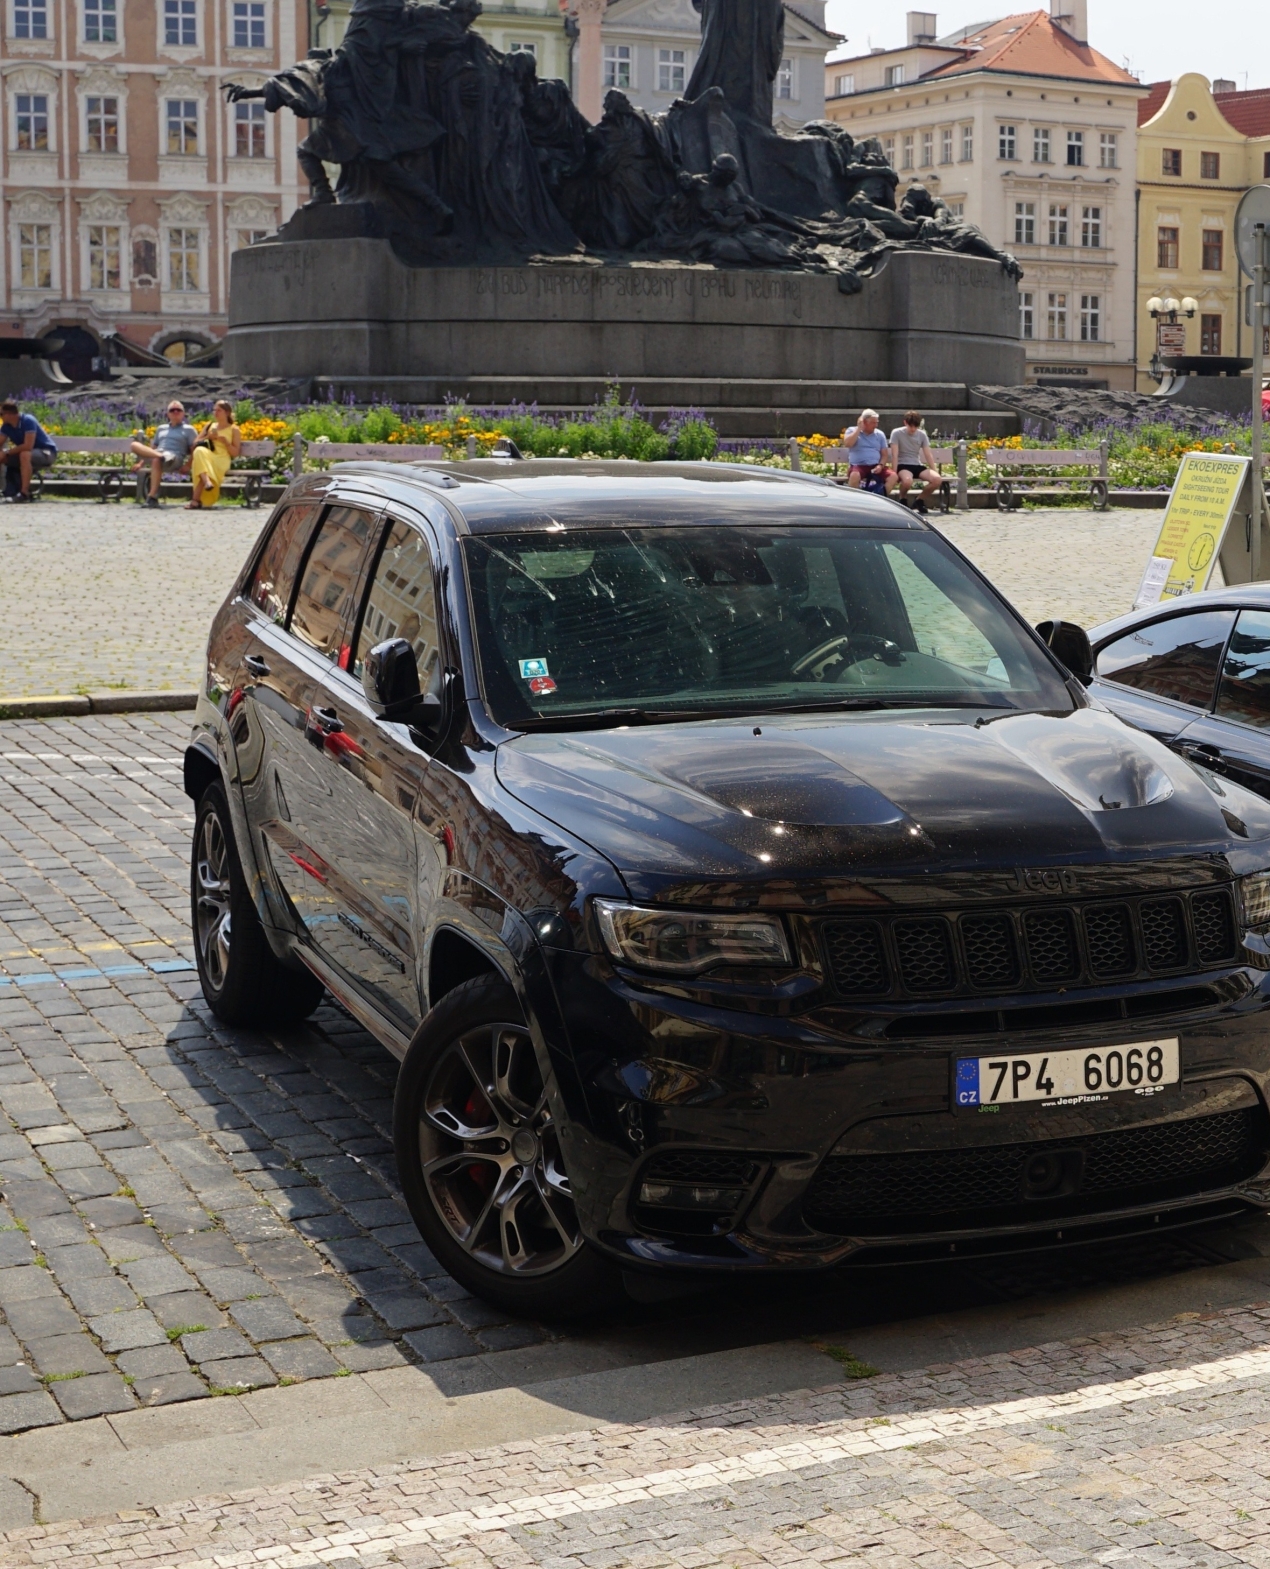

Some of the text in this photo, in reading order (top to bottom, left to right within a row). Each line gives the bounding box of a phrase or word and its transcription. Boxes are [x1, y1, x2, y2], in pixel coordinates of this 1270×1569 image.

[1033, 366, 1088, 375] STARBUCKS
[1188, 460, 1240, 475] EKOEXPRES
[1183, 484, 1215, 493] SIGHTSEEING
[1006, 868, 1077, 894] Jeep
[988, 1046, 1163, 1102] 7P4 6068
[960, 1091, 977, 1104] CZ
[978, 1104, 999, 1113] Jeep
